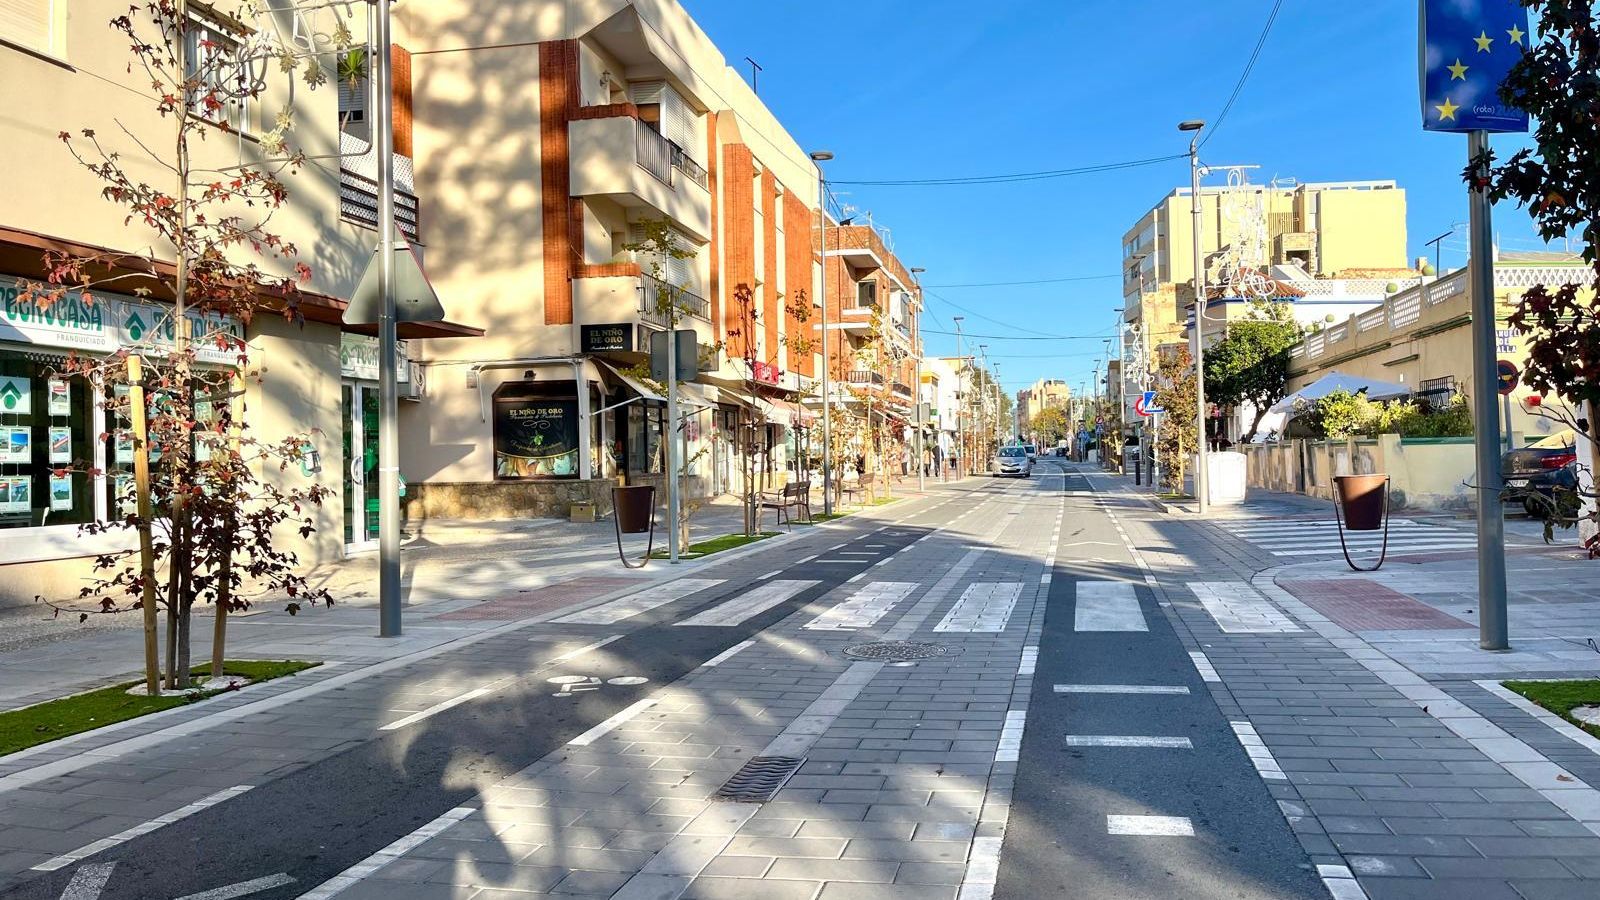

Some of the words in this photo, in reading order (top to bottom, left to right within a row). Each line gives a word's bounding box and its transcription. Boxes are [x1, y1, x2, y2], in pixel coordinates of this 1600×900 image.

[602, 328, 623, 336] NIÑO
[56, 334, 105, 345] FRANQUICIADO
[519, 408, 536, 416] NIÑO
